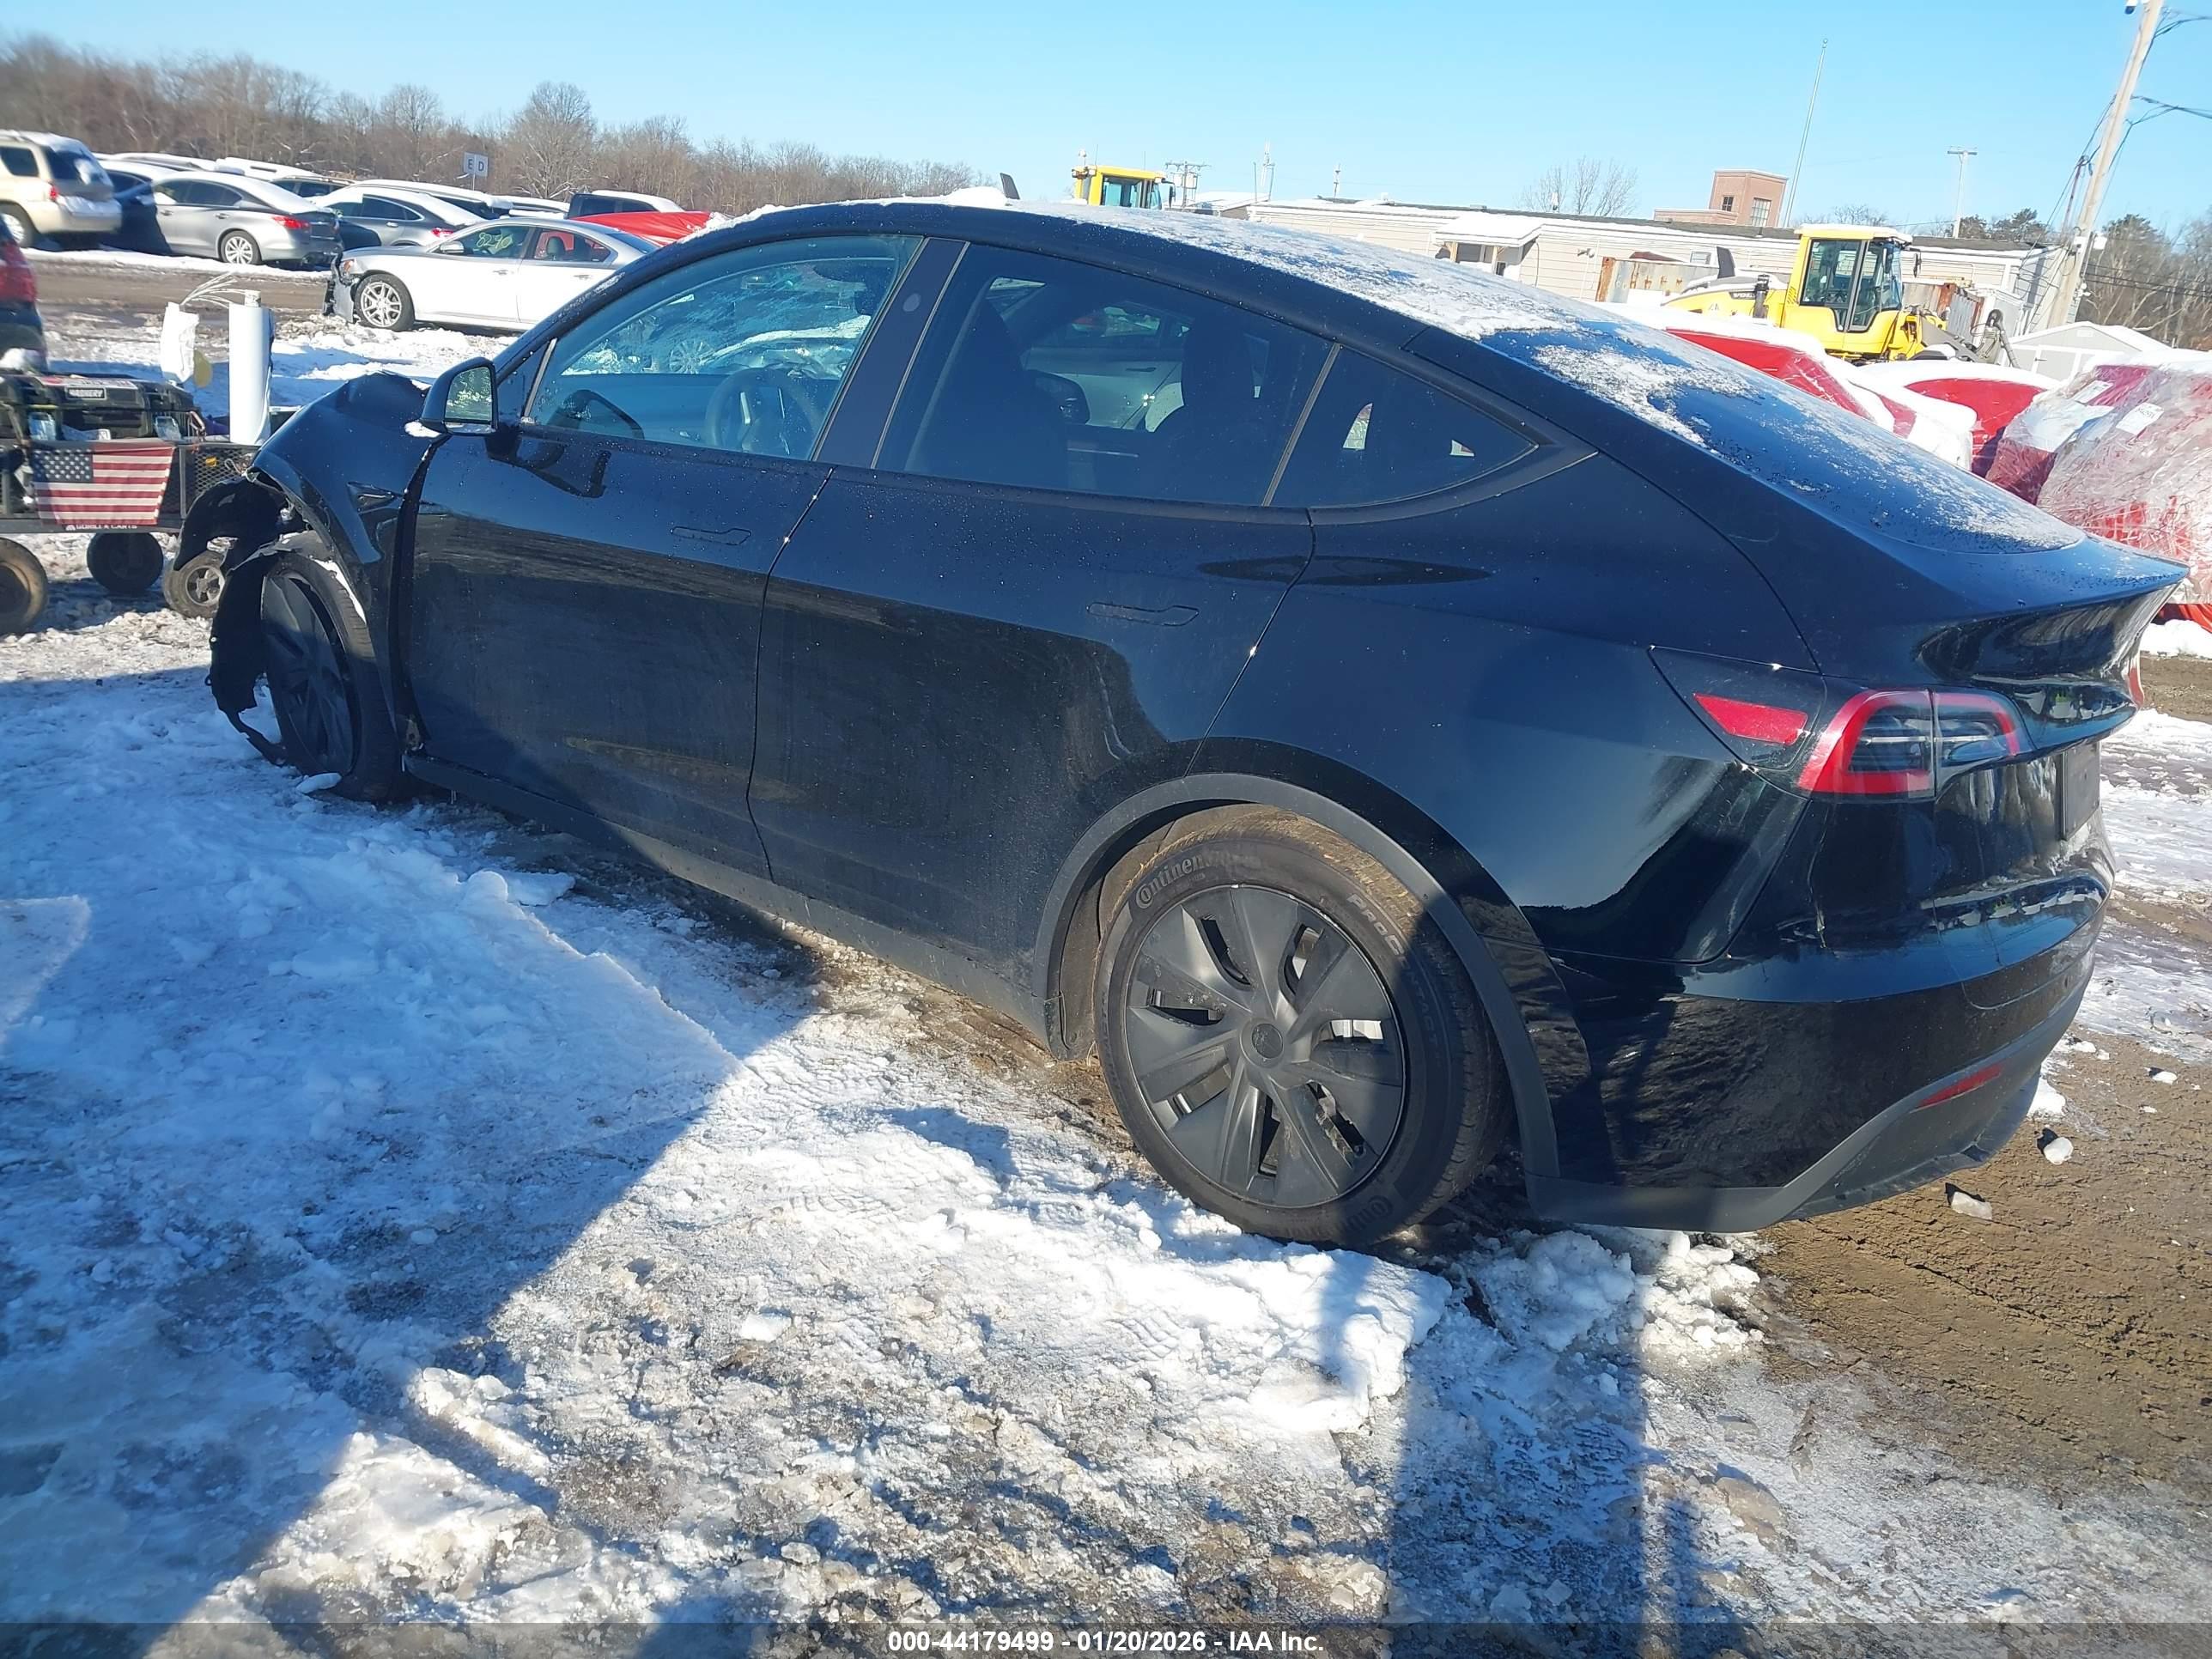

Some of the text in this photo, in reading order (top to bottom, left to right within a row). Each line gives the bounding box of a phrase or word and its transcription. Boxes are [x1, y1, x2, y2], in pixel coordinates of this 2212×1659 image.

[467, 158, 484, 172] E D
[1135, 854, 1226, 910] Continen
